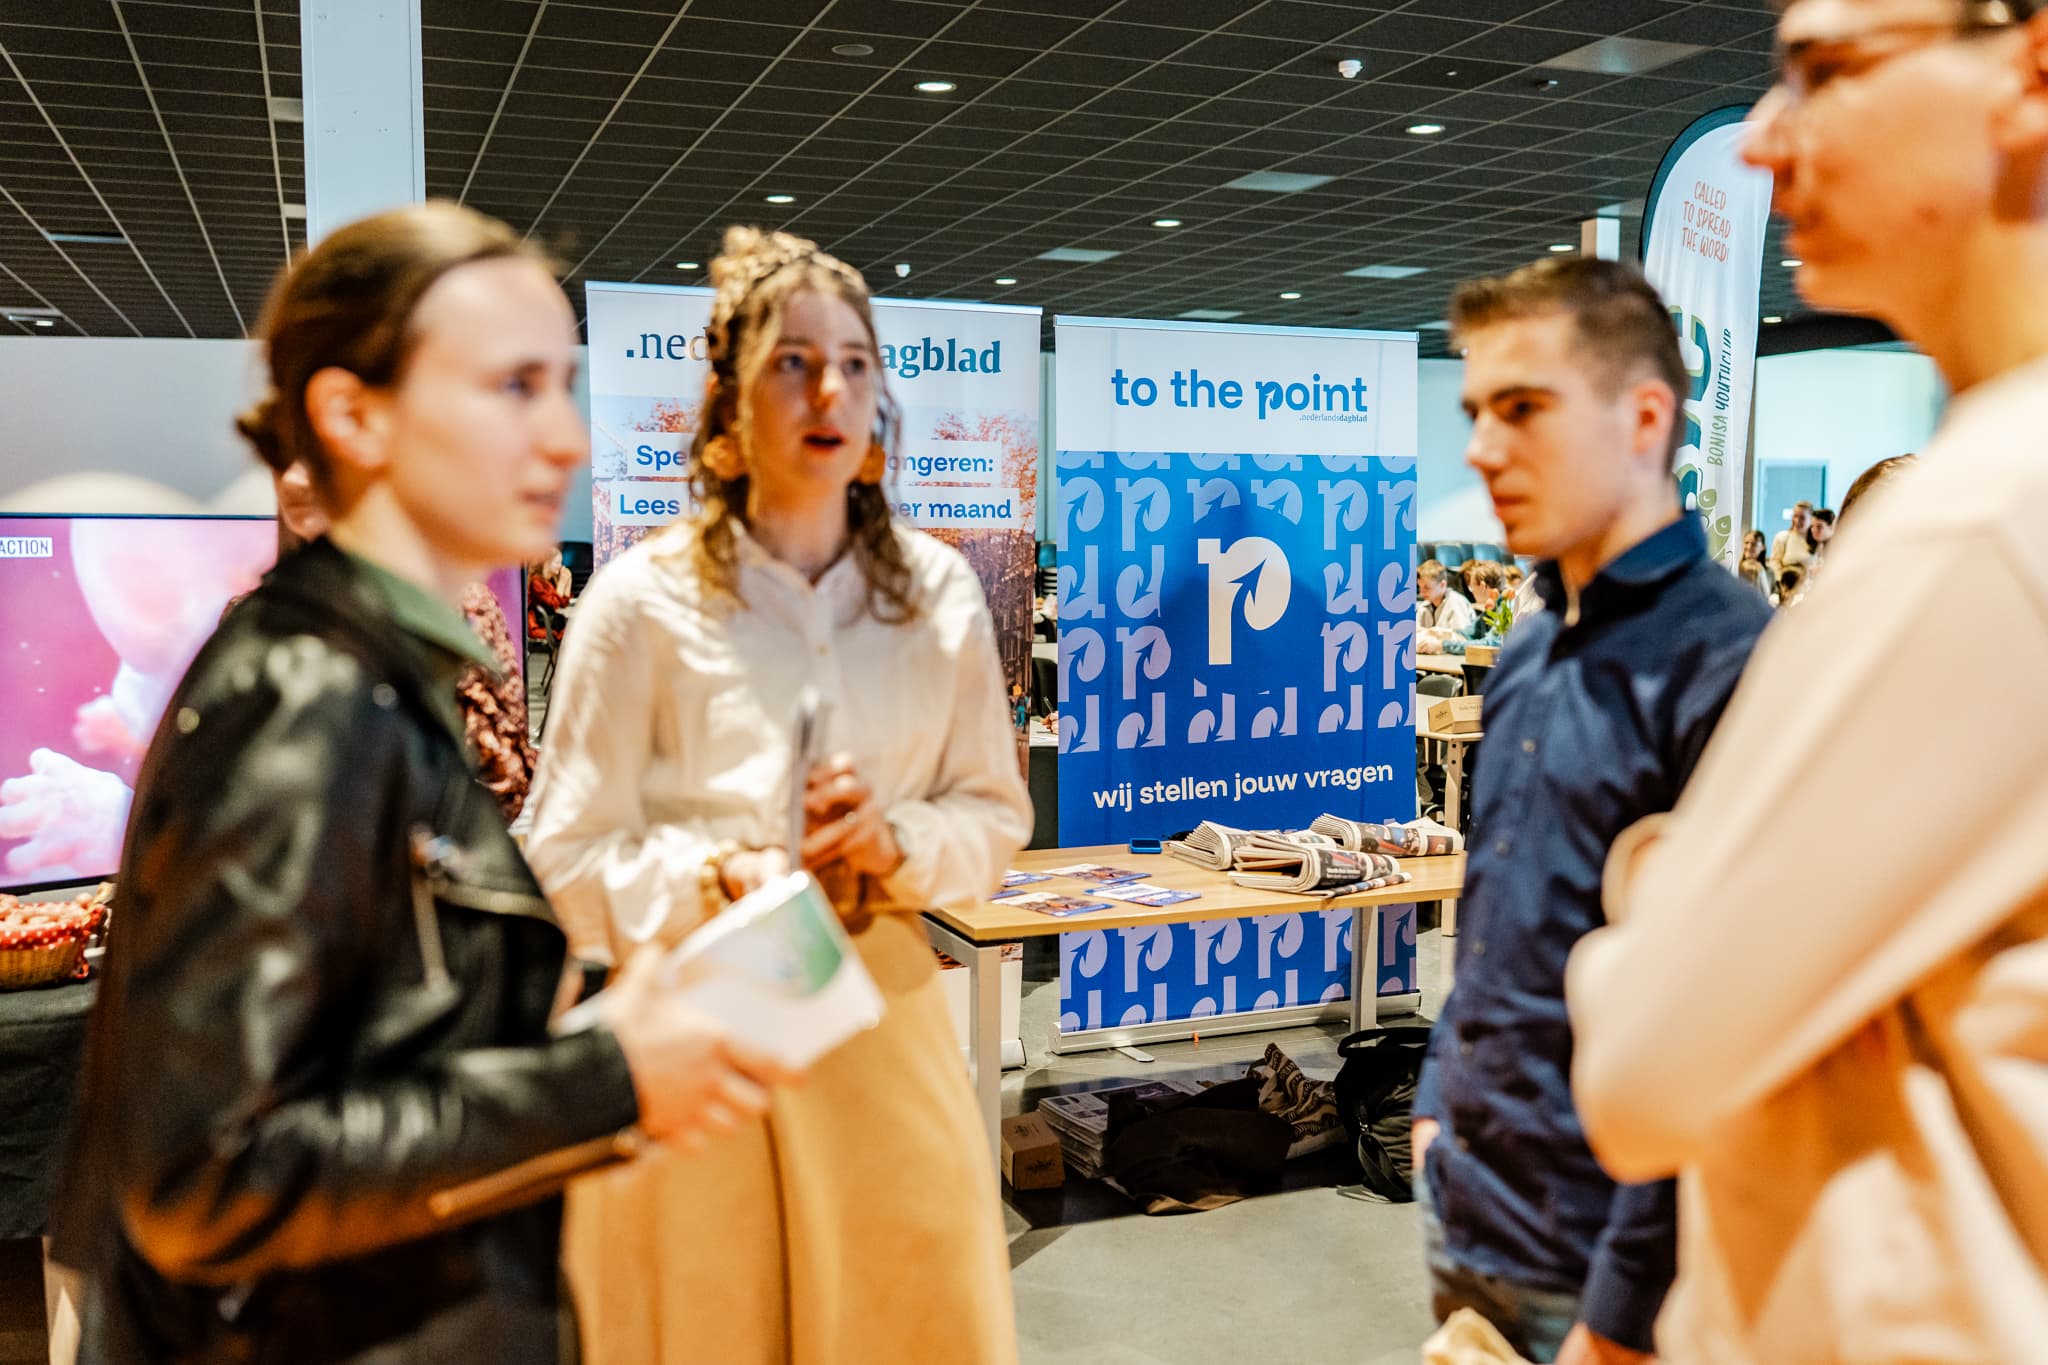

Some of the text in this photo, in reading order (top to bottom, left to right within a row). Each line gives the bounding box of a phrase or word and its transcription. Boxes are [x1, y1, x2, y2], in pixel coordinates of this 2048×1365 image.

[1694, 181, 1726, 210] CALLED
[1683, 201, 1731, 238] TO SPREAD
[1682, 227, 1696, 252] THE
[879, 337, 1001, 379] agblad
[1111, 369, 1368, 420] to the point
[1707, 414, 1728, 467] BONISA
[636, 445, 993, 476] Spe ongeren:
[620, 494, 680, 516] Lees
[929, 499, 1011, 518] maand
[1093, 764, 1393, 813] wij stellen jouw vragen
